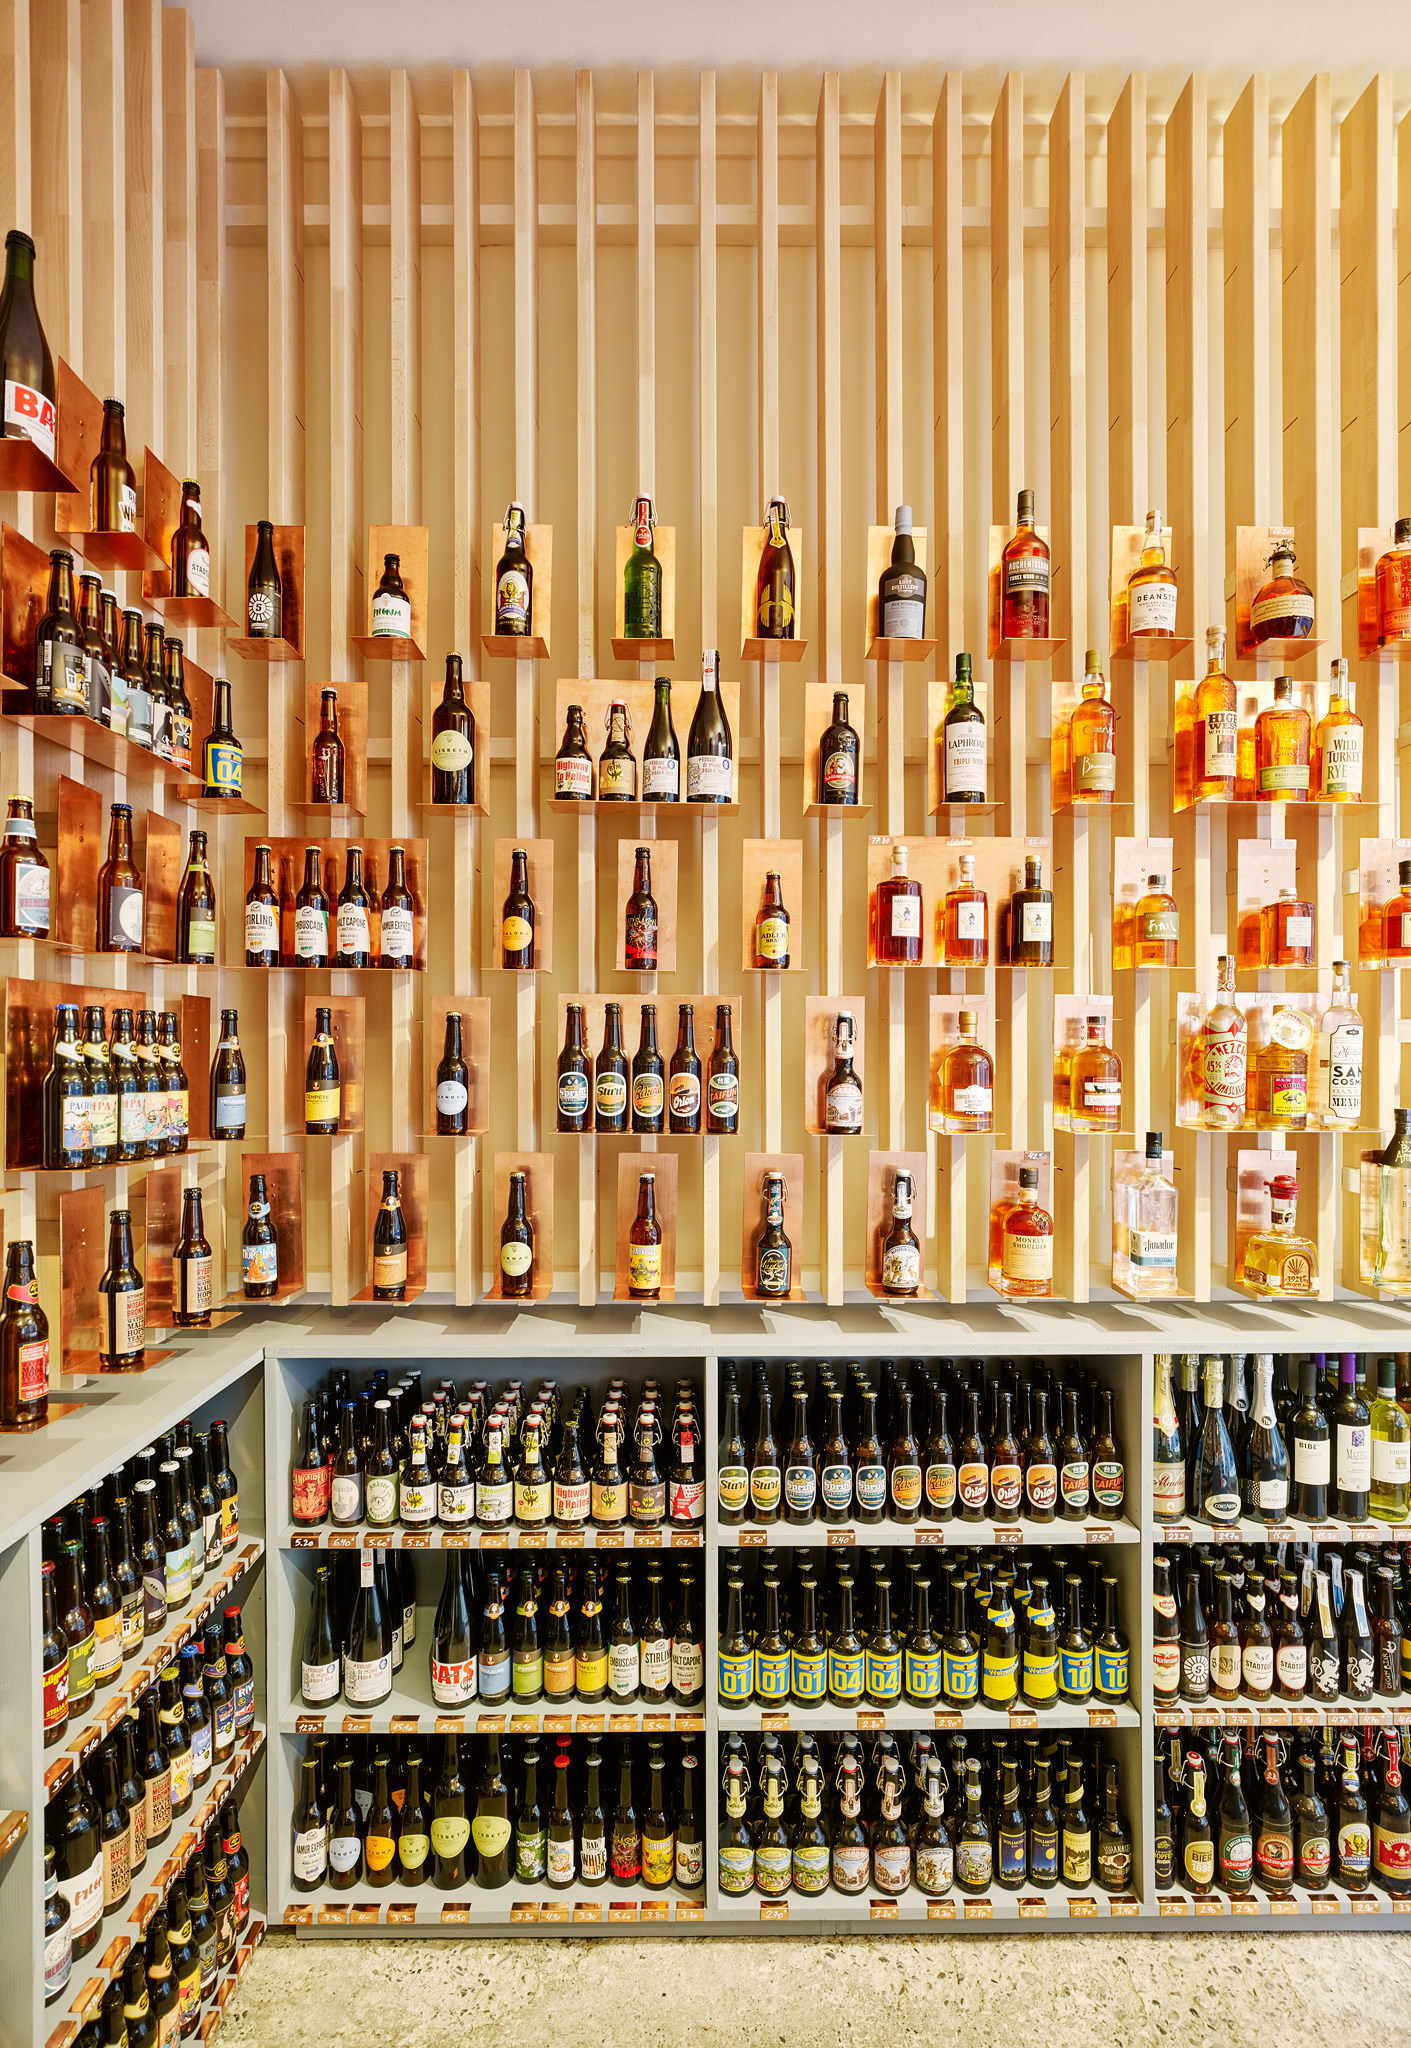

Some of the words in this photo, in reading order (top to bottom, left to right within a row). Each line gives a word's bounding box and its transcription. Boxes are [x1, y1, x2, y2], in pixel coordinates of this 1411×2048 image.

[1333, 739, 1357, 751] WILD
[1327, 751, 1361, 764] TURKEY
[216, 760, 242, 785] 04
[557, 760, 589, 774] Highway
[1328, 764, 1353, 780] RYE
[557, 771, 564, 782] To
[565, 771, 590, 784] Helles
[125, 1099, 142, 1109] IPA
[675, 1095, 696, 1109] Orion
[1144, 1239, 1174, 1252] Jimador
[720, 1480, 746, 1490] Start
[752, 1480, 778, 1490] Start
[1096, 1476, 1122, 1489] TAIFUN
[556, 1487, 588, 1499] Highway
[964, 1485, 987, 1500] Orion
[997, 1486, 1019, 1500] Orion
[1032, 1485, 1055, 1500] Orion
[556, 1498, 564, 1508] To
[565, 1497, 590, 1510] Helles
[295, 1539, 314, 1547] 5.20
[333, 1539, 350, 1547] 6.40
[369, 1539, 387, 1547] 5.60
[407, 1539, 425, 1547] 5.20
[446, 1539, 463, 1547] 5.20
[485, 1539, 502, 1547] 6.20
[524, 1539, 541, 1547] 5.20
[561, 1538, 578, 1546] 6.20
[601, 1538, 618, 1546] 5.20
[638, 1538, 655, 1546] 5.20
[675, 1538, 693, 1546] 6.20
[744, 1536, 763, 1544] 2.50
[831, 1536, 849, 1544] 2.40
[920, 1535, 938, 1543] 2.50
[1000, 1535, 1017, 1543] 2.60
[1092, 1534, 1109, 1542] 2.50
[432, 1659, 474, 1686] BATS
[1068, 1667, 1090, 1689] 10
[1105, 1667, 1127, 1689] 10
[724, 1671, 747, 1692] 01
[762, 1671, 785, 1692] 01
[799, 1671, 822, 1692] 01
[834, 1670, 861, 1692] 04
[872, 1670, 898, 1692] 04
[912, 1669, 937, 1692] 02
[951, 1669, 977, 1692] 02
[1015, 1719, 1032, 1727] 3.20
[581, 1852, 606, 1865] WHITE
[1192, 1853, 1212, 1862] BIER
